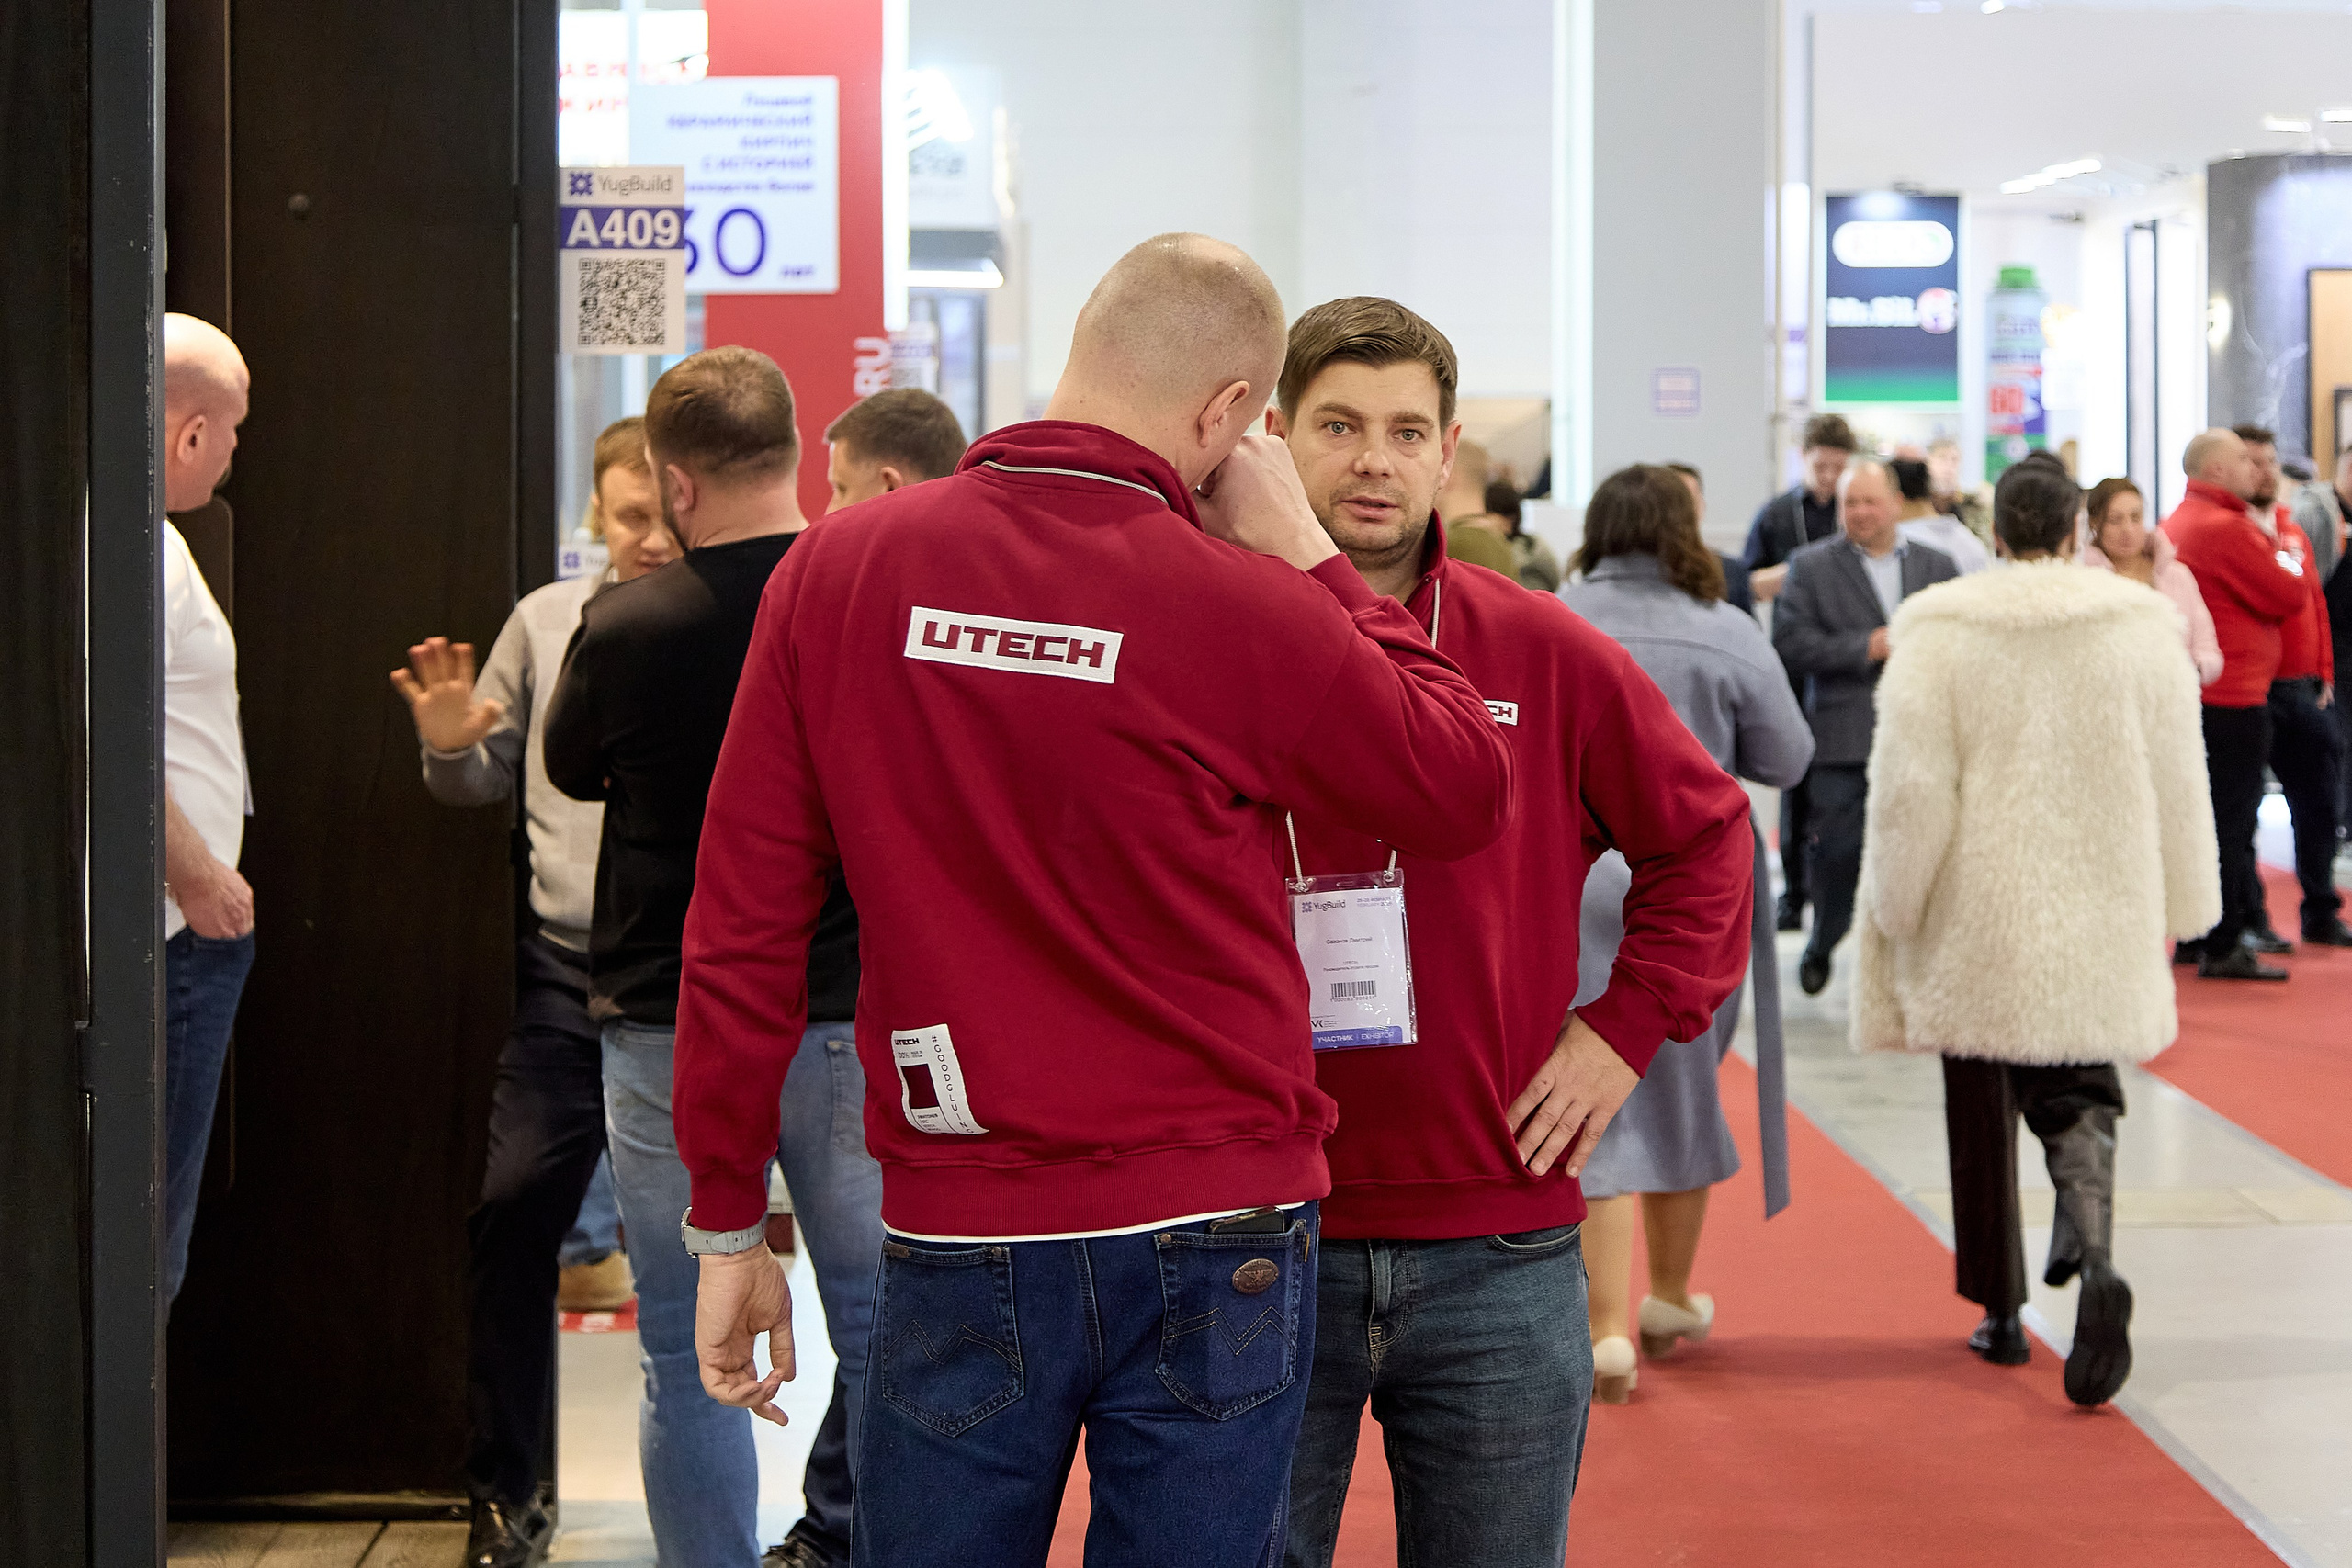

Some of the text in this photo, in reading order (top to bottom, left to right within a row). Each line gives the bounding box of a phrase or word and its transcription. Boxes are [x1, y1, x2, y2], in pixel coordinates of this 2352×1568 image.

[598, 175, 673, 196] YugBuild
[565, 209, 682, 249] A409
[922, 620, 1106, 669] UTECH
[1313, 900, 1346, 912] YugBuild
[1317, 1034, 1354, 1043] УЧАСТНИК
